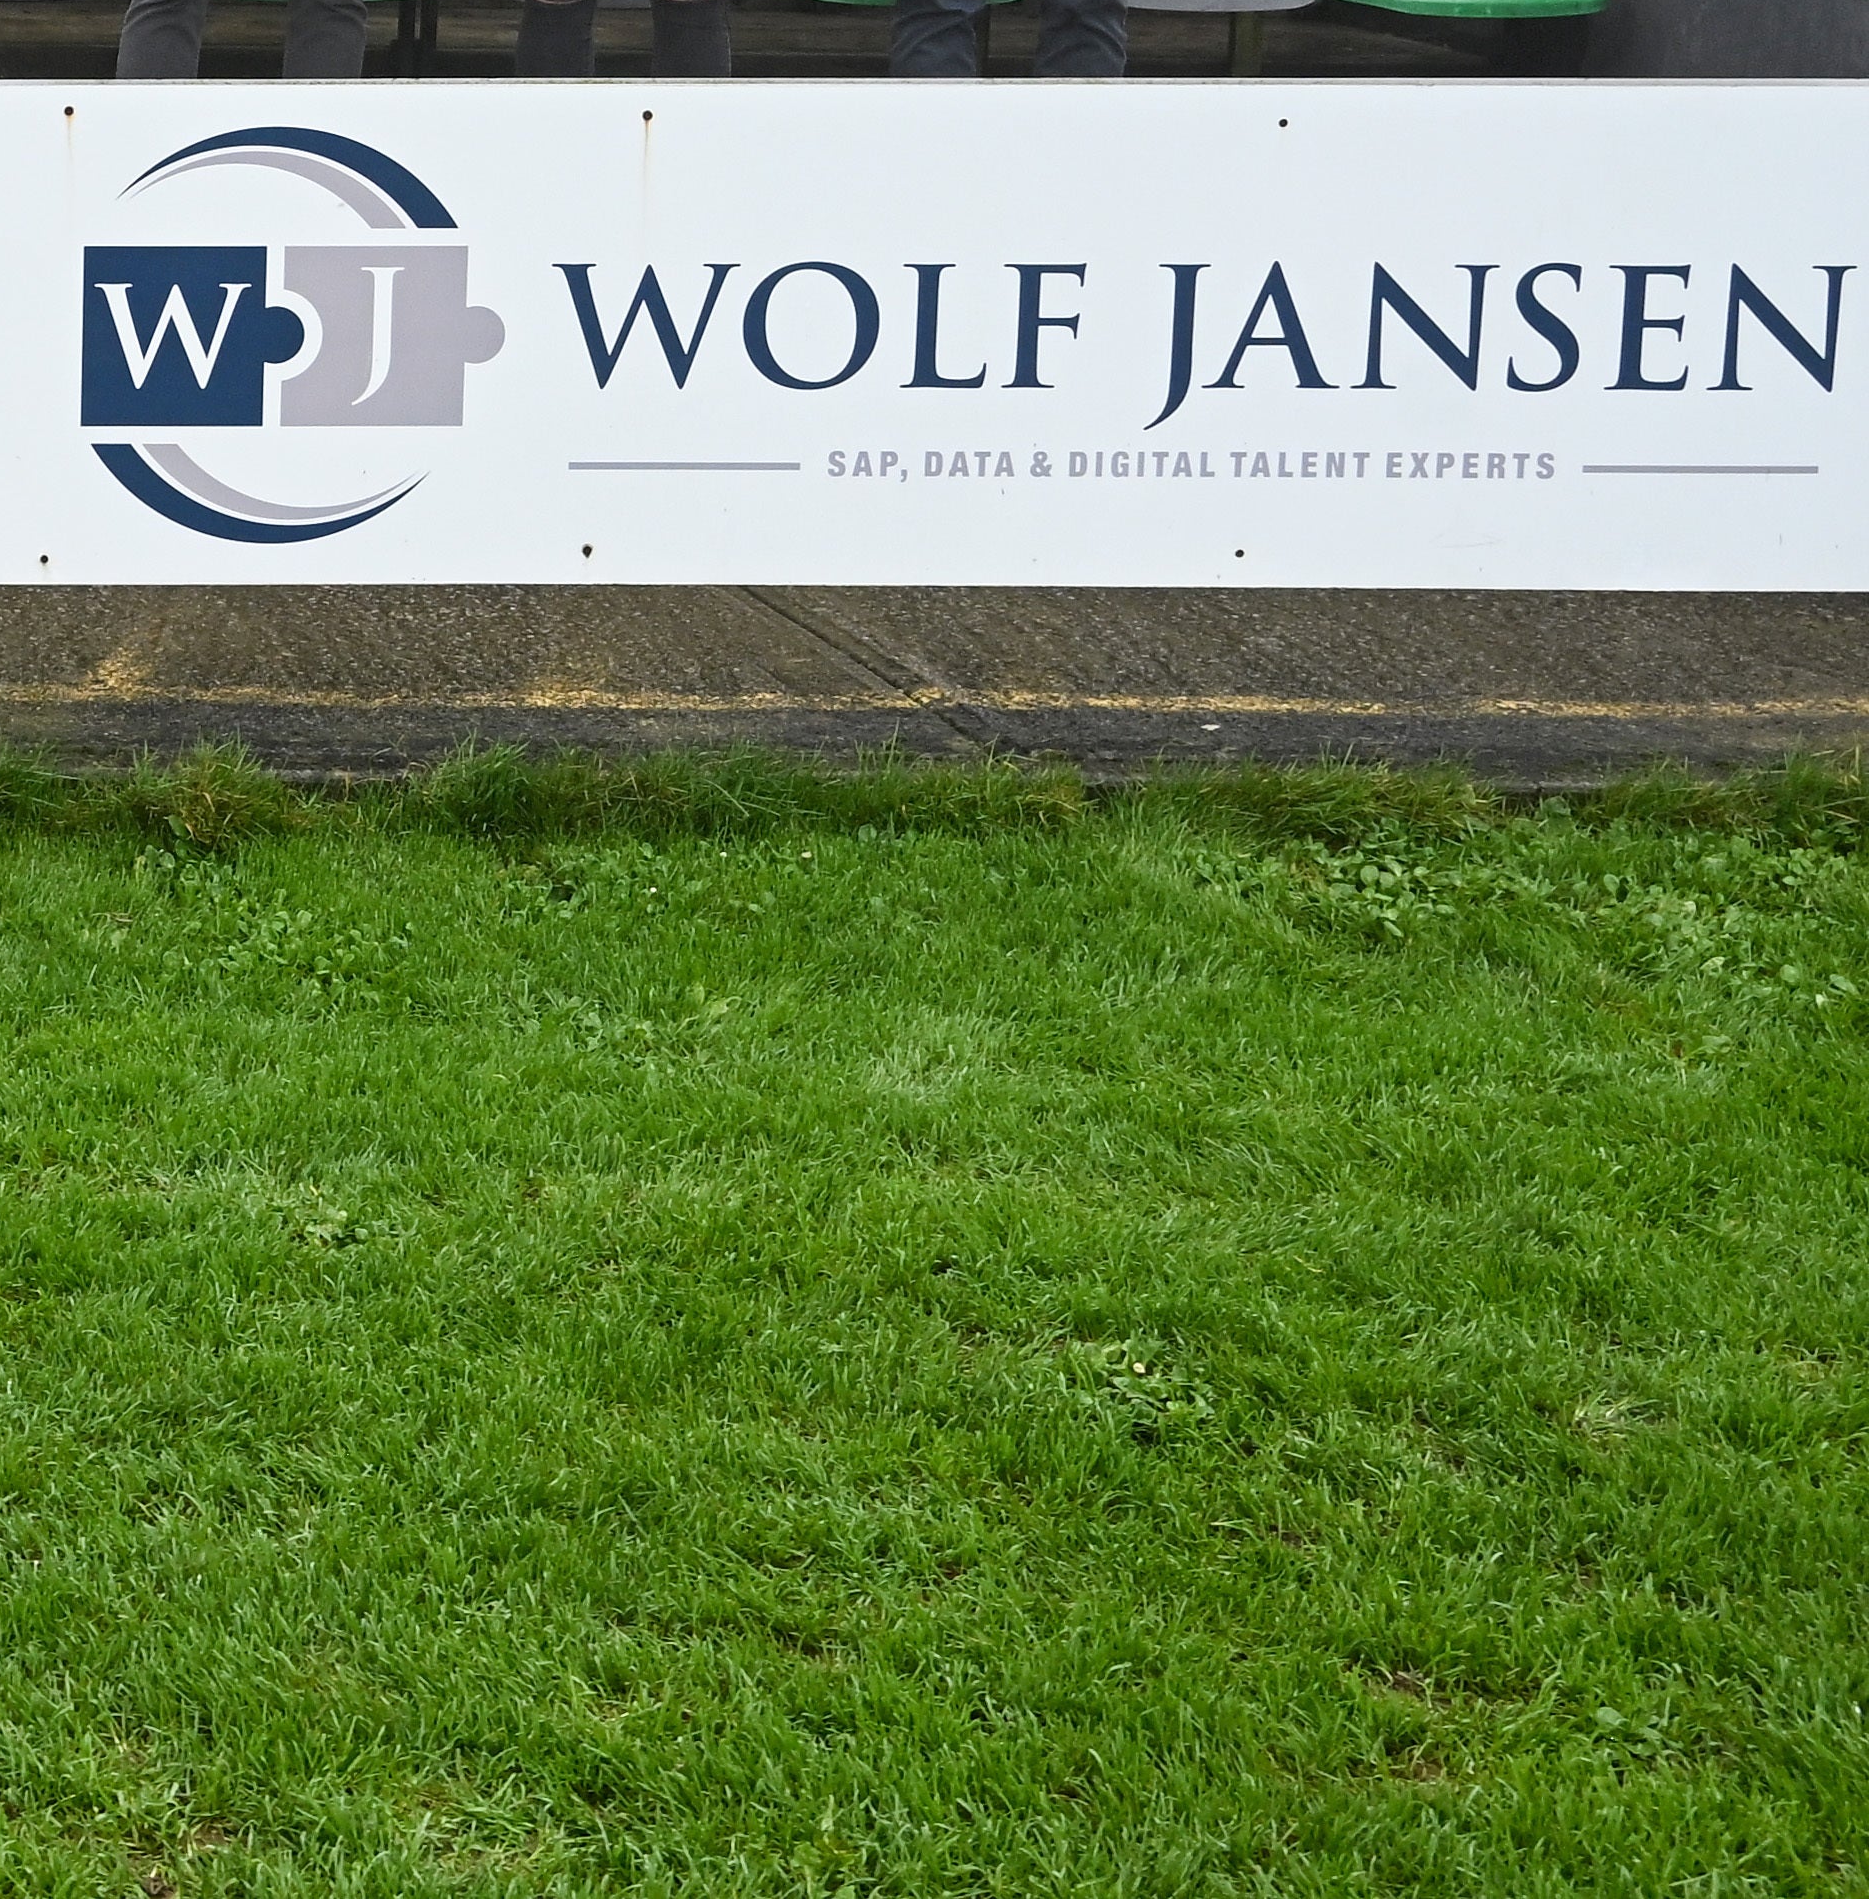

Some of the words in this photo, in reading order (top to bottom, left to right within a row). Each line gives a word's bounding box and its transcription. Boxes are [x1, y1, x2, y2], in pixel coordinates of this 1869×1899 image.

[552, 260, 1088, 391] WOLF
[1143, 260, 1858, 431] JANSEN
[827, 448, 907, 485] SAP,
[924, 449, 1014, 478] DATA
[1029, 450, 1053, 478] &
[1068, 450, 1216, 479] DIGITAL
[1229, 451, 1371, 480] TALENT
[1385, 451, 1556, 480] EXPERTS
